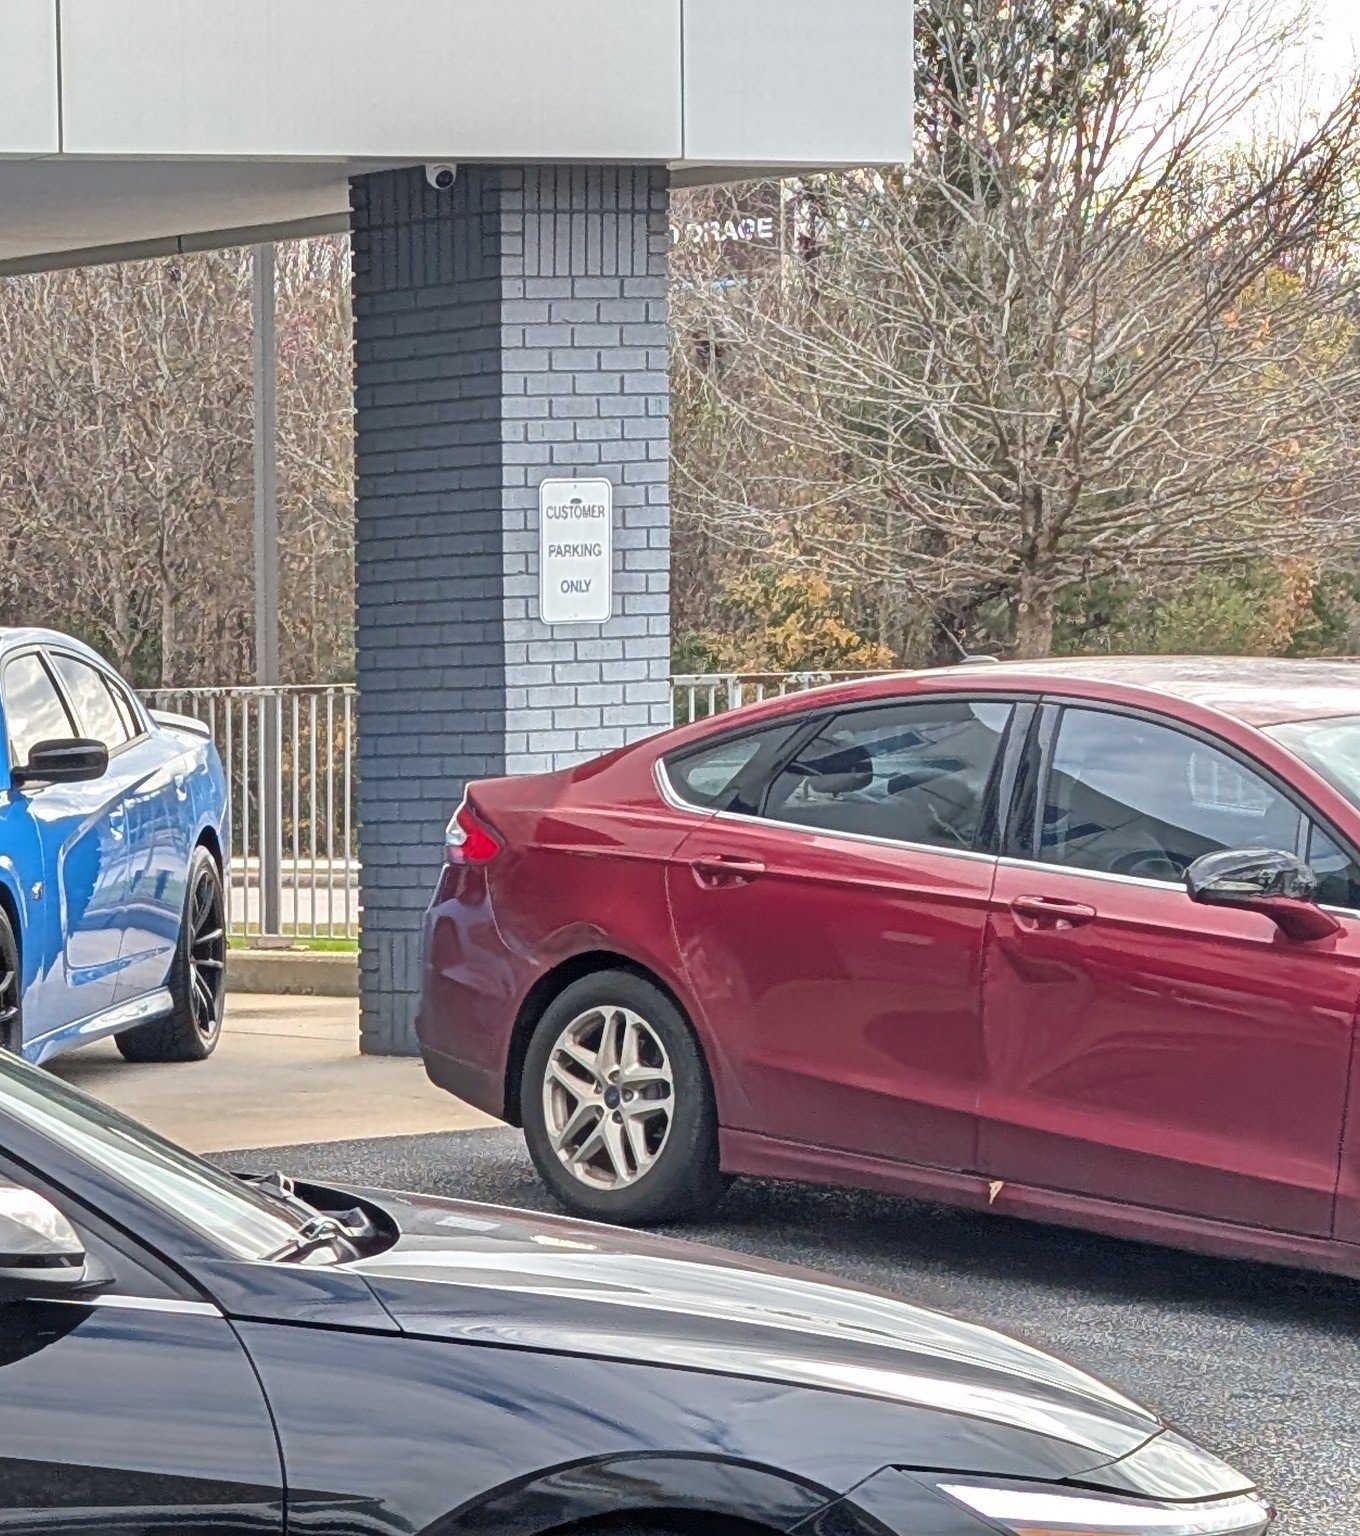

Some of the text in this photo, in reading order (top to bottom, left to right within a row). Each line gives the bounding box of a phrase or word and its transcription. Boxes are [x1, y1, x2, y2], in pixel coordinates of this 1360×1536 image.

[546, 504, 605, 520] CUSTOMER
[548, 543, 602, 558] PARKING
[560, 579, 592, 594] ONLY
